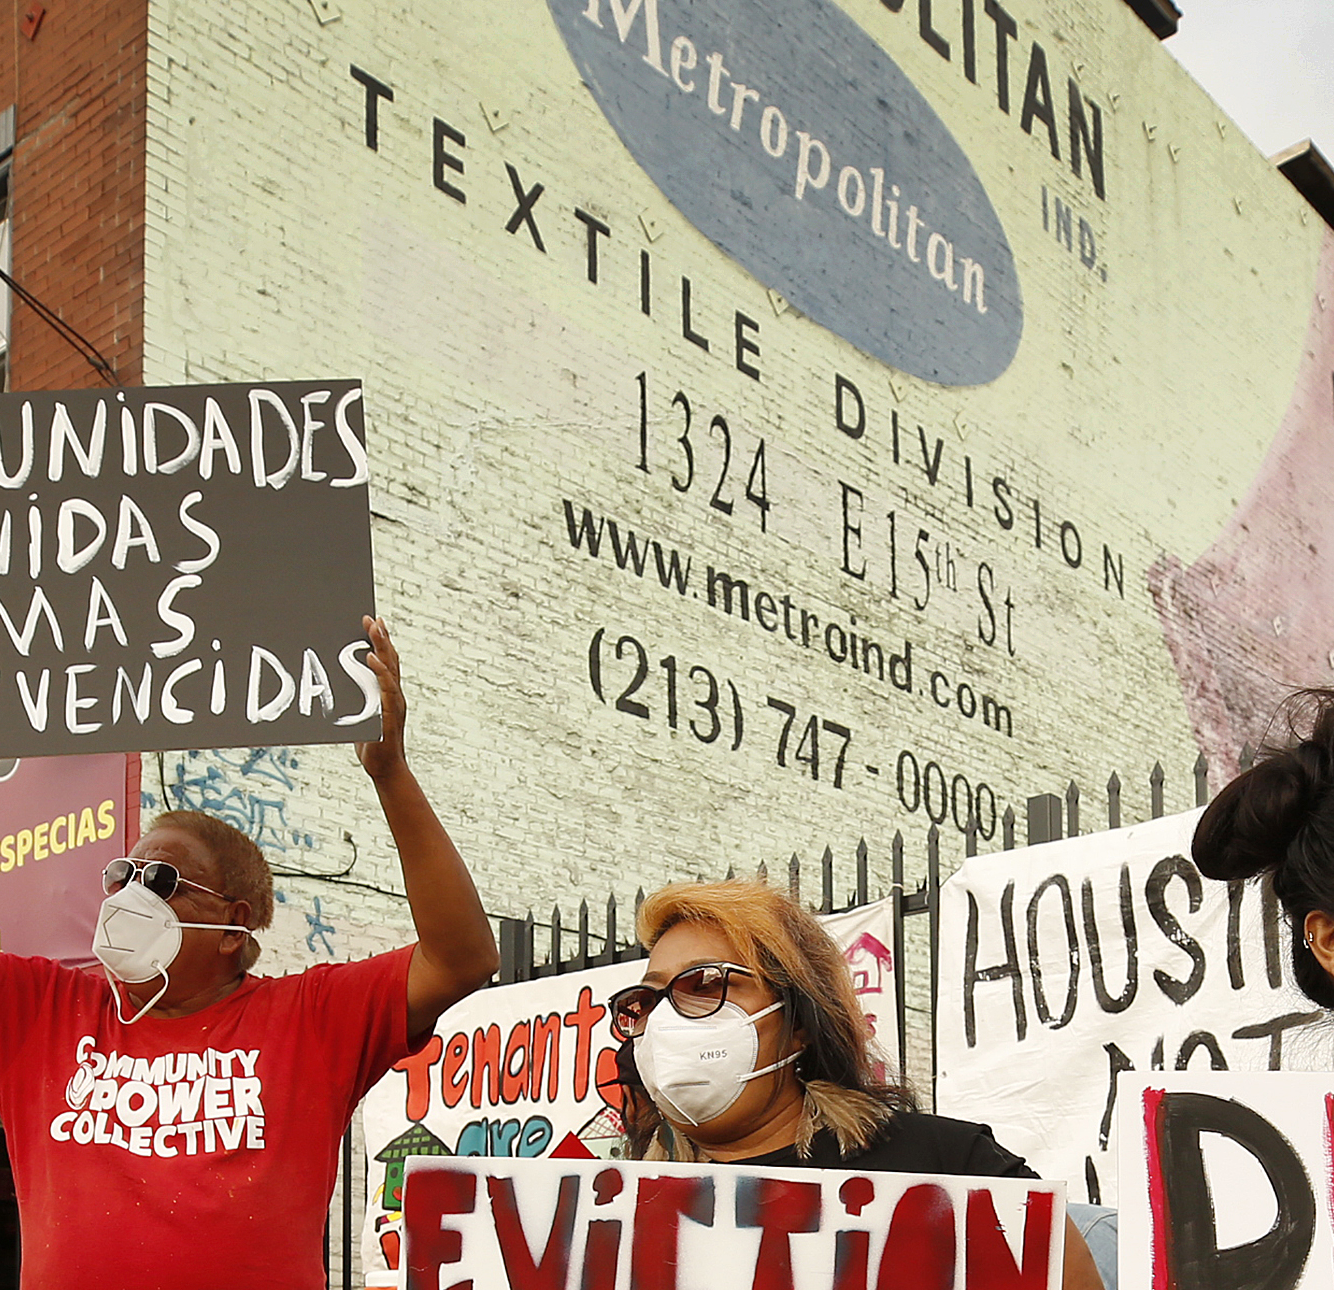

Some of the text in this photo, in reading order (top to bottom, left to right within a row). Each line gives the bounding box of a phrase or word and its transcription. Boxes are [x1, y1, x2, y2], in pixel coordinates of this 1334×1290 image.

[582, 0, 990, 315] Metropolitan
[350, 64, 1126, 600] TEXTILE DIVISION
[634, 370, 772, 534] 1324
[976, 560, 1017, 660] St
[561, 498, 1013, 739] www.metroind.com
[587, 627, 745, 752] (213)
[963, 854, 1280, 1049] HOUSI
[50, 1110, 266, 1158] COLLECTIVE
[76, 1035, 260, 1085] COMMUNITY
[89, 1075, 265, 1127] POWER
[699, 1050, 728, 1061] KN95
